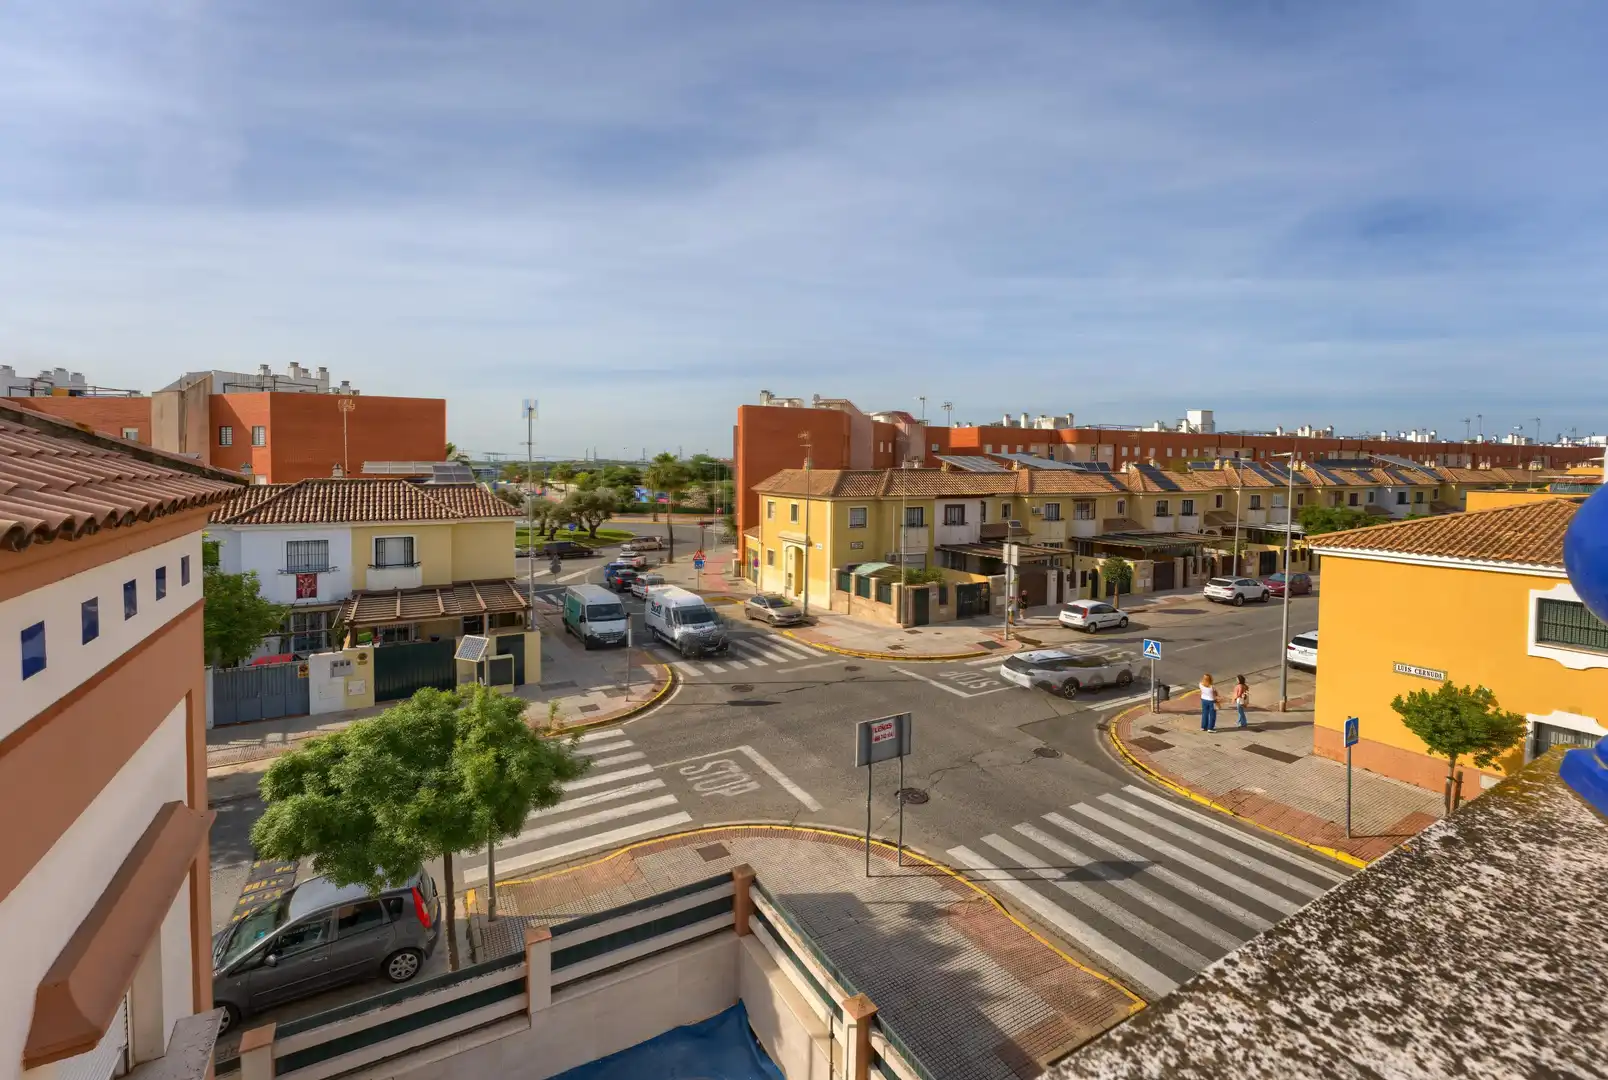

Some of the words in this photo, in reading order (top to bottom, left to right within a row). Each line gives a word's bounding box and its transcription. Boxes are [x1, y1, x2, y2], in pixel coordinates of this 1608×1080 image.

[938, 671, 1000, 689] STOP
[1397, 664, 1411, 672] LUIS
[1414, 668, 1442, 679] CERNUDA
[679, 759, 761, 797] STOP
